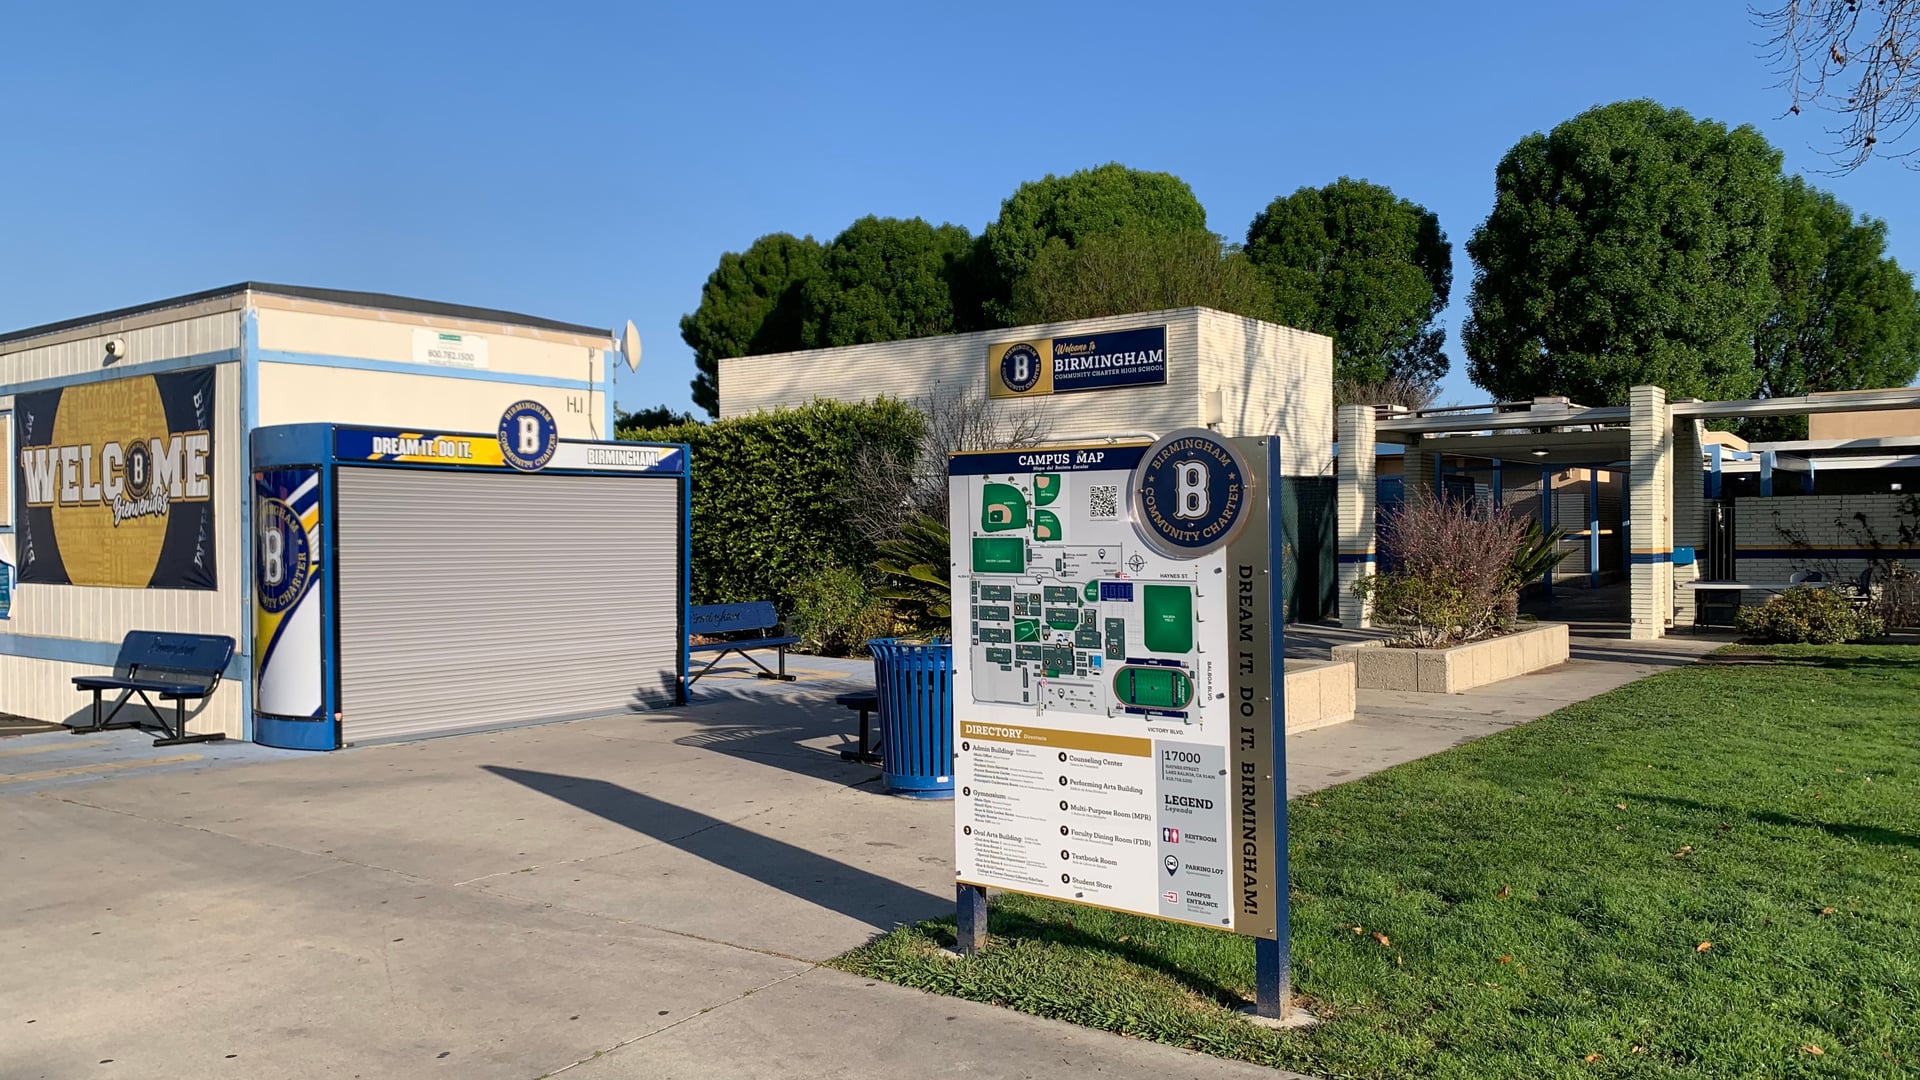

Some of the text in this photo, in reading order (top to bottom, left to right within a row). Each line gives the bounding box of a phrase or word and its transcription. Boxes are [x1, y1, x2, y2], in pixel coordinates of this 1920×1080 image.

[1055, 342, 1087, 356] Welcome
[1013, 354, 1029, 381] B
[1054, 349, 1163, 372] BIRMINGHAM
[1055, 371, 1090, 380] COMMUNITY
[1138, 365, 1163, 373] SCHOOL
[504, 402, 551, 422] BIRMINGHAM
[517, 415, 539, 454] B
[372, 436, 473, 458] DREAM IT. DO IT.
[500, 431, 556, 468] COMMUNITY CHARTER
[1151, 439, 1232, 470] BIRMINGHAM
[587, 448, 659, 466] BIRMINGHAM!
[1019, 452, 1104, 465] CAMPUS MAP
[22, 432, 209, 505] WELCOME
[1172, 459, 1211, 520] B
[112, 487, 170, 527] Bienvenidos
[1145, 483, 1239, 541] COMMUNITY CHARTER
[265, 527, 284, 586] B
[279, 552, 306, 606] CHARTER
[965, 724, 1022, 739] DIRECTORY
[1238, 564, 1258, 915] DREAM IT. DO IT. BIRMINGHAM!
[1070, 755, 1101, 765] Counseling
[1164, 750, 1201, 764] 17000
[1070, 779, 1102, 789] Performing
[1118, 785, 1143, 795] Building
[1164, 794, 1214, 810] LEGEND
[1165, 805, 1192, 814] Leyenda
[1071, 804, 1112, 815] Multi-Purpose
[1113, 810, 1131, 818] Room
[1132, 813, 1151, 821] (MPR)
[974, 829, 985, 837] Oral
[1071, 829, 1092, 839] Faculty
[1094, 833, 1113, 842] Dining
[1133, 838, 1151, 847] (FDR)
[1185, 834, 1217, 843] RESTROOM
[1072, 853, 1099, 863] Textbook
[1100, 857, 1117, 866] Room
[1186, 864, 1211, 873] PARKING
[1212, 867, 1224, 875] LOT
[1072, 877, 1095, 886] Student
[1096, 881, 1112, 889] Store
[1187, 891, 1211, 899] CAMPUS
[1187, 898, 1218, 908] ENTRANCE
